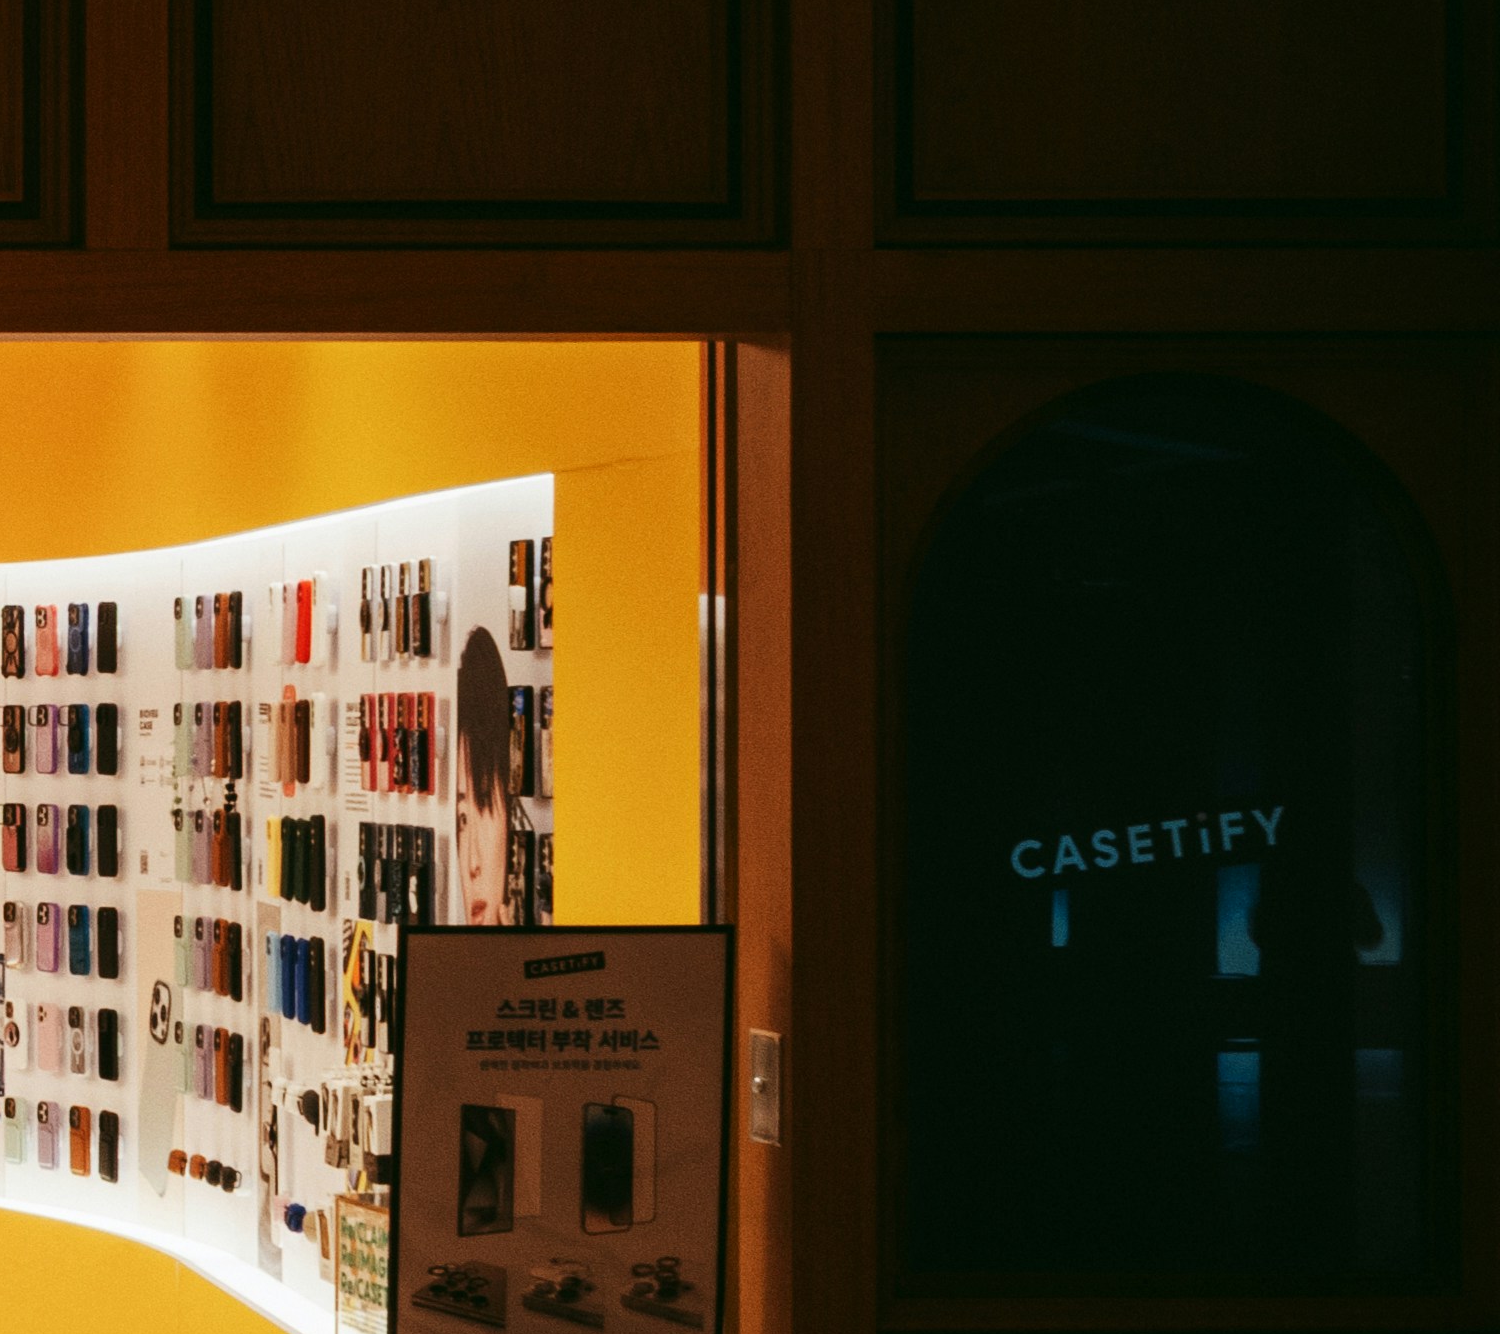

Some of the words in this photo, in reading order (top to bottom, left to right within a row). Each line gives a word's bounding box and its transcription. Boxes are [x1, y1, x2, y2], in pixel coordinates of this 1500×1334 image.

[1011, 806, 1285, 878] CASETiFY
[530, 956, 600, 975] CASETiFY
[496, 998, 557, 1020] 스크린
[562, 1000, 579, 1018] &
[585, 998, 626, 1020] 렌즈
[466, 1029, 547, 1052] 프로텍터
[552, 1029, 592, 1052] 부착
[598, 1029, 660, 1052] 서비스
